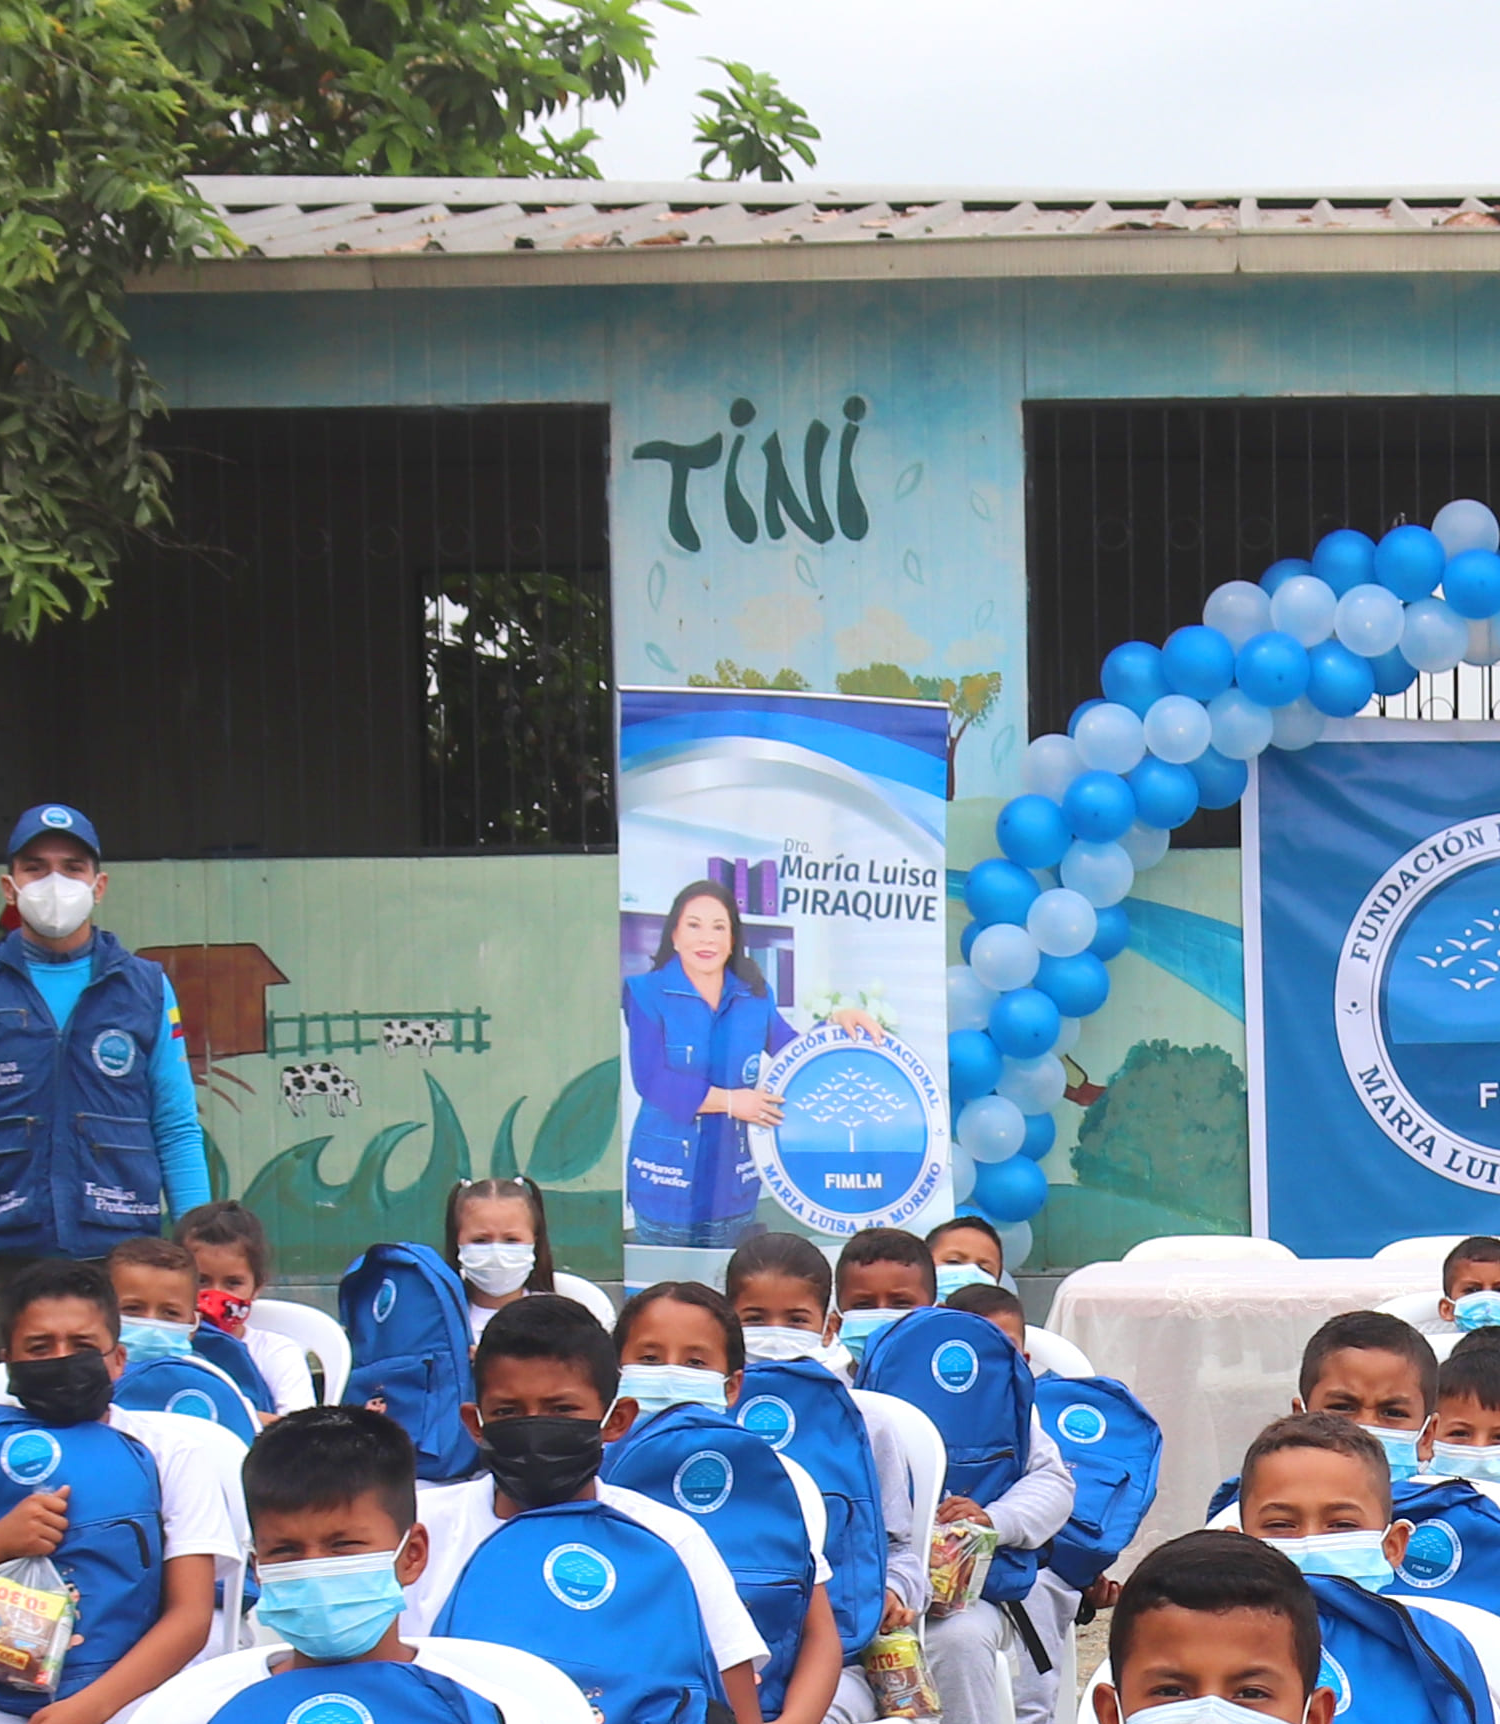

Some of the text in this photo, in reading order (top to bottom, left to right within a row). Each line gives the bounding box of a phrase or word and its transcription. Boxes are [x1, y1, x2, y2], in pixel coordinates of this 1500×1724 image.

[780, 853, 938, 888] María Luisa
[784, 838, 813, 854] Dra.
[781, 887, 938, 922] PIRAQUIVE
[1350, 826, 1486, 964] FUNDACIÓN
[764, 1030, 828, 1094] UNDACIÓN
[1358, 1065, 1437, 1158] MARIA
[762, 1163, 804, 1216] MARIA
[808, 1210, 858, 1234] LUISA
[889, 1161, 941, 1225] MORENO
[824, 1172, 882, 1189] FIMLM
